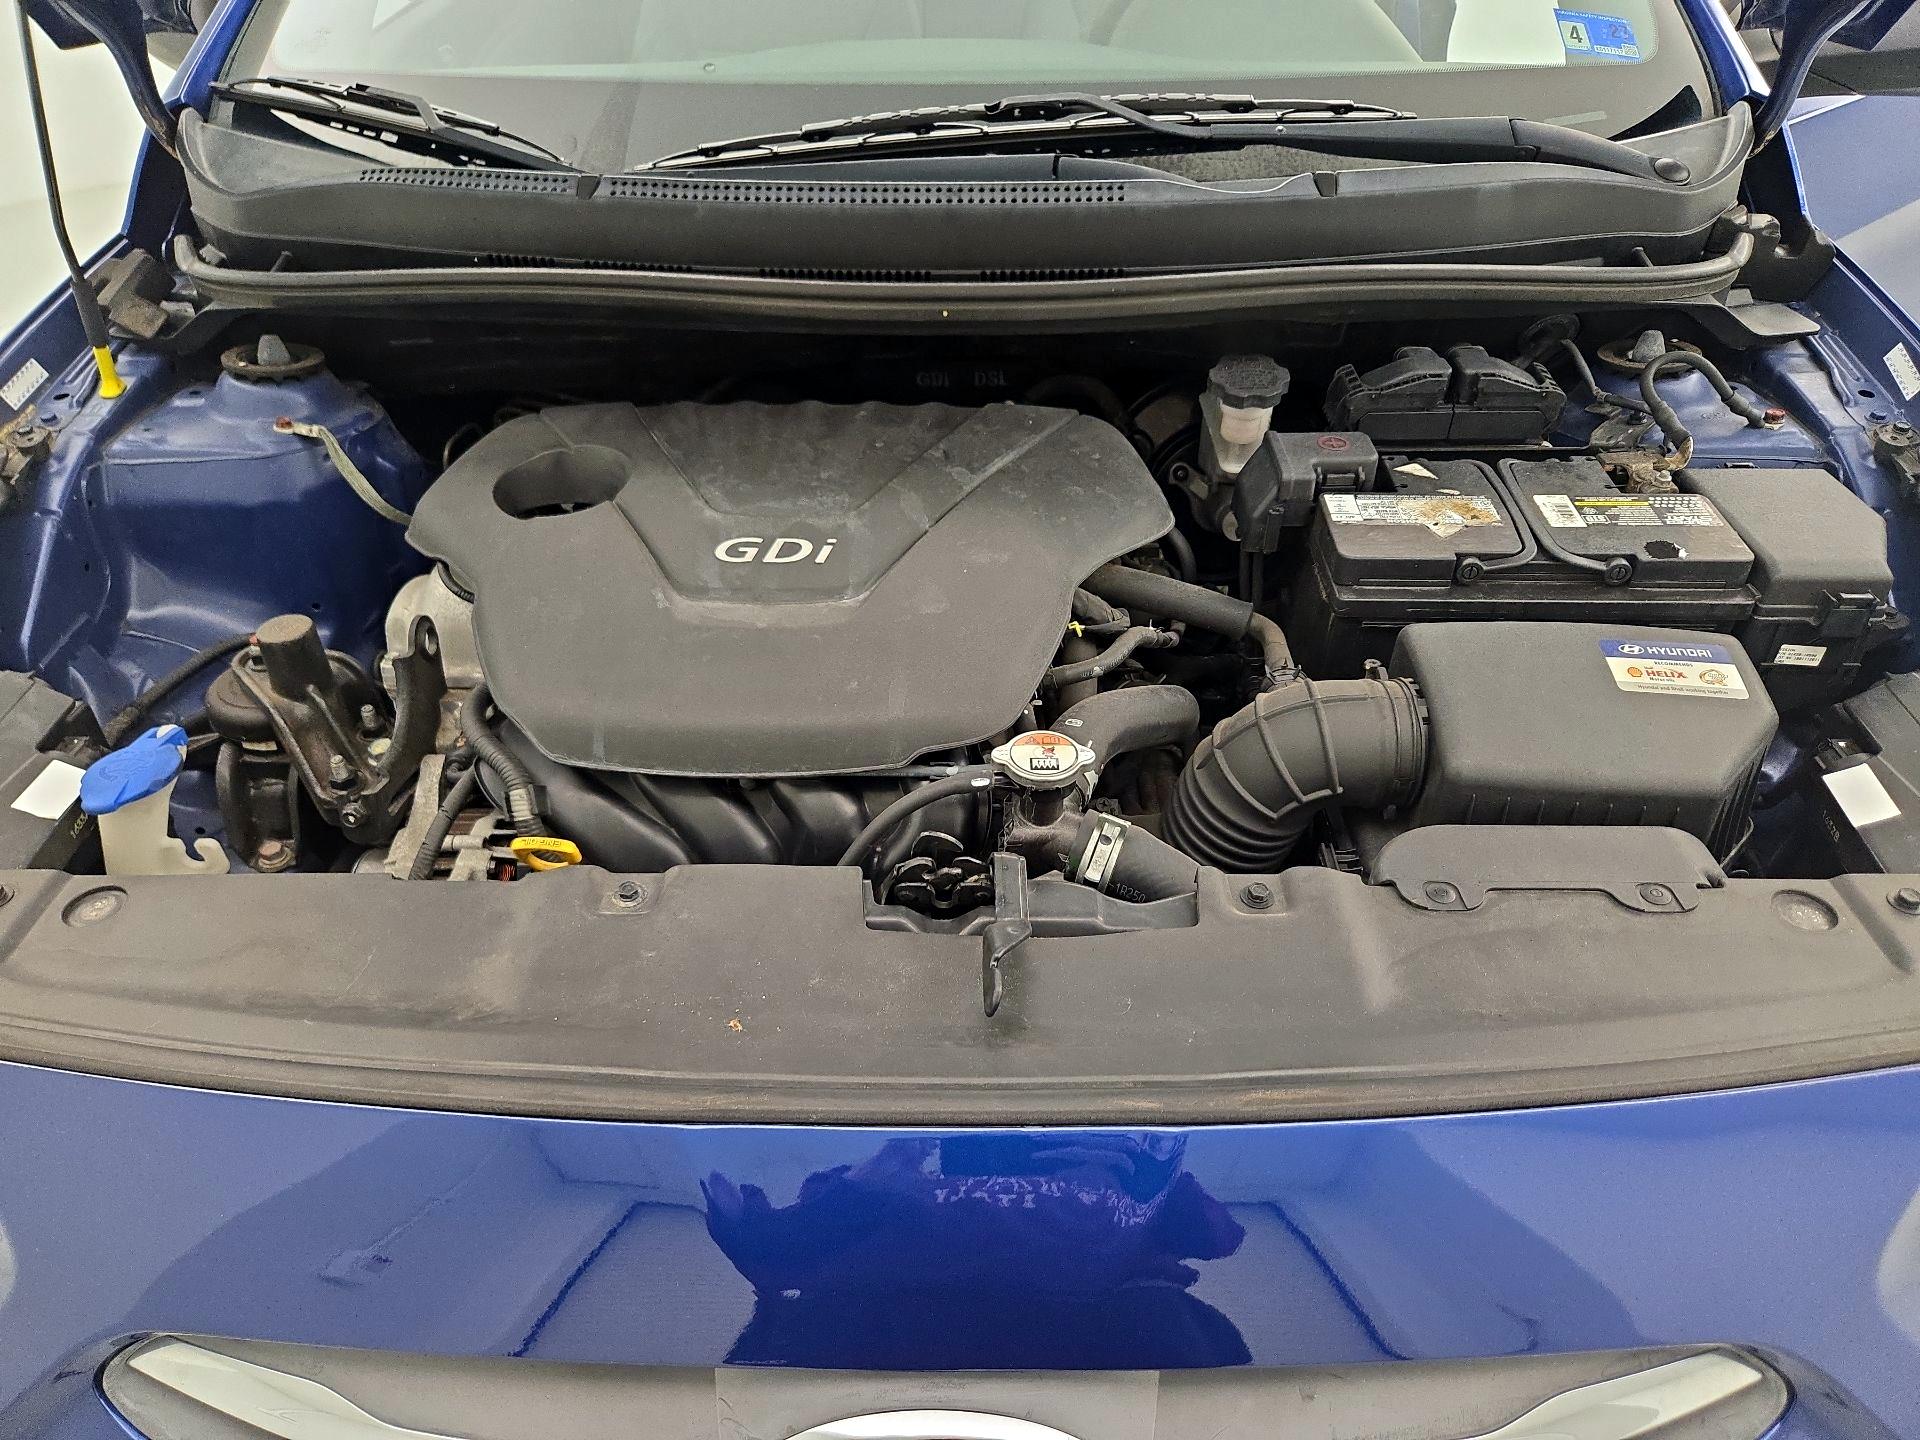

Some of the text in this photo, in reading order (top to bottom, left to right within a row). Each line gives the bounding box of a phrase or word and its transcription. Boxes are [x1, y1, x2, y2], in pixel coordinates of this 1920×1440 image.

[1570, 25, 1583, 43] 4
[714, 537, 838, 563] GDi
[1647, 646, 1713, 658] HYUNDAI
[1645, 669, 1688, 679] HELIX
